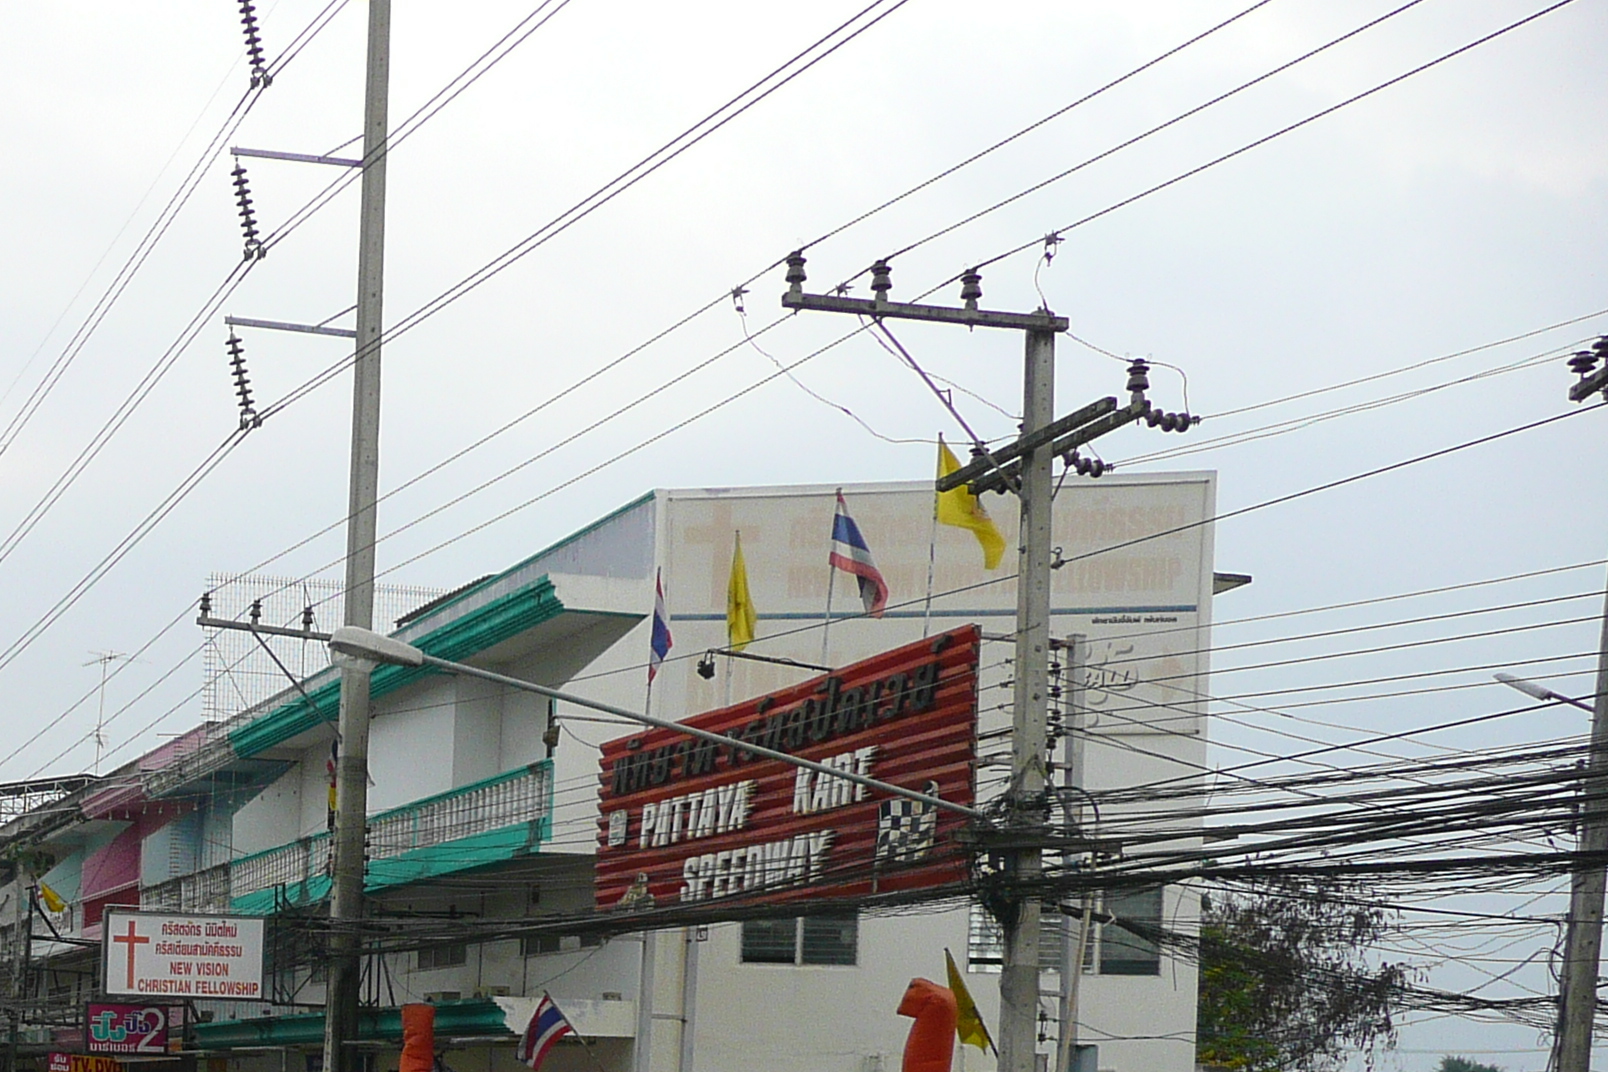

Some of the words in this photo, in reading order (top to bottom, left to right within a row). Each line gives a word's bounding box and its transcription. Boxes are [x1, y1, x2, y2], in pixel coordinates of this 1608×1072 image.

[639, 778, 759, 850] PATTAYA
[793, 744, 882, 815] KART
[679, 828, 838, 902] SPEEDWAY
[137, 979, 192, 993] CHRISTIAN
[195, 980, 259, 995] FELLOWSHIP
[169, 962, 193, 975] NEW
[196, 962, 229, 976] VISION
[136, 1006, 165, 1053] 2
